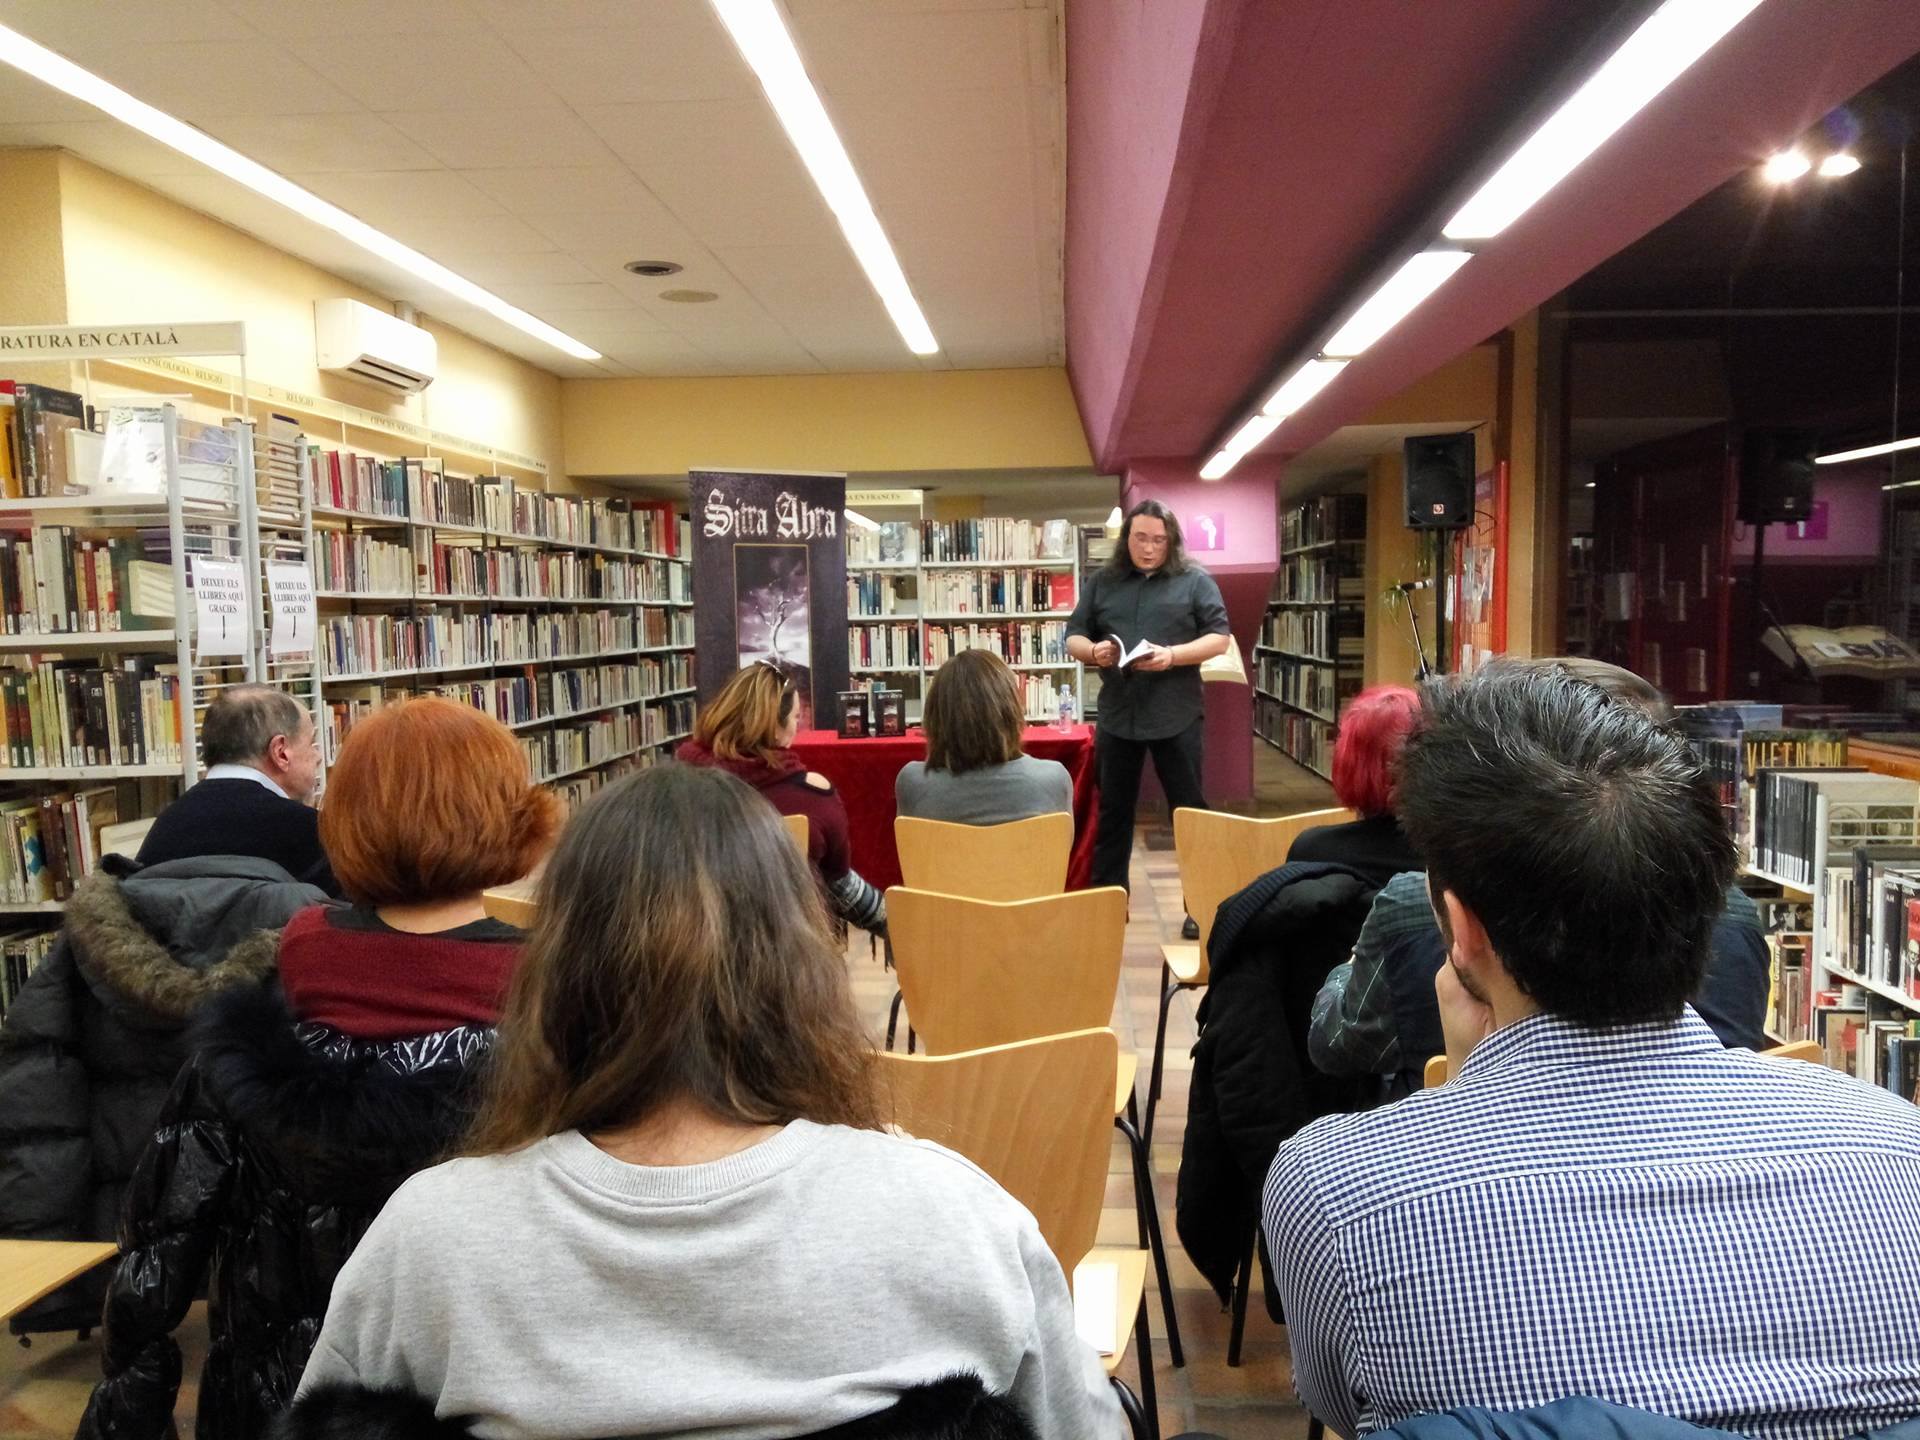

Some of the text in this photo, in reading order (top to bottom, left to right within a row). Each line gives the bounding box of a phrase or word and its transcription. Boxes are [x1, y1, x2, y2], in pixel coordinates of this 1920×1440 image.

[0, 328, 179, 349] RATURA EN CATALÀ
[704, 488, 837, 540] Sitra Ahra
[201, 577, 239, 588] DEIXEU ELS
[199, 591, 227, 600] LLIBRES
[273, 594, 298, 602] LLIBRES
[1747, 742, 1842, 777] VIETNAM
